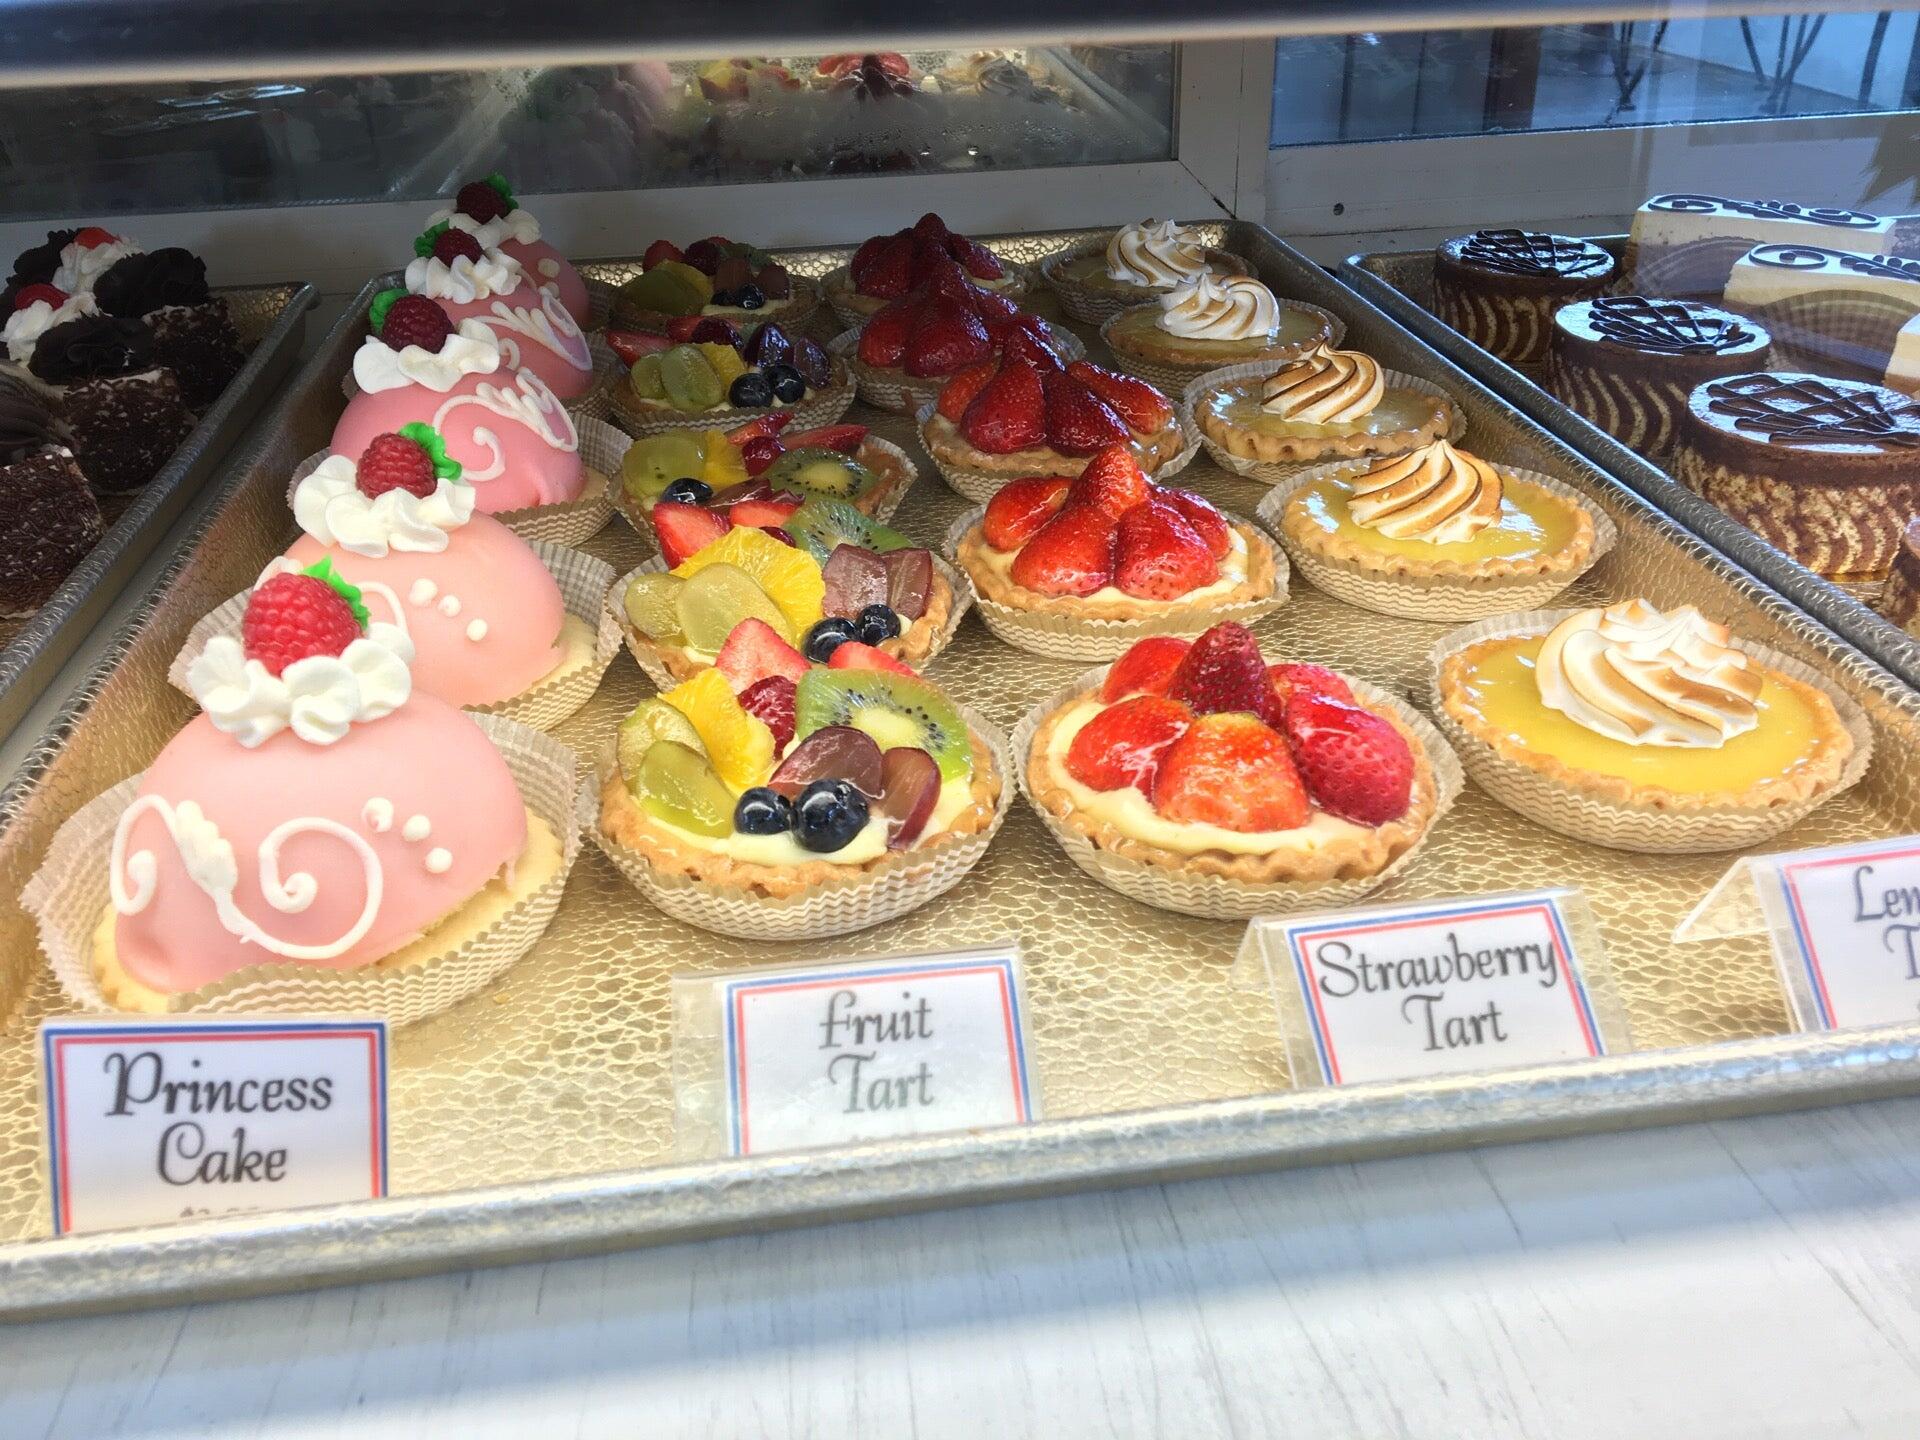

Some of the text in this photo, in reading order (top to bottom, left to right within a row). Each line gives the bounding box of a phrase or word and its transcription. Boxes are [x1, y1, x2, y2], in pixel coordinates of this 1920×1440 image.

[1317, 933, 1558, 997] Strawberry
[1402, 992, 1508, 1051] Tart
[104, 1052, 333, 1117] Princess
[828, 1051, 934, 1114] Tart
[157, 1121, 288, 1186] Cake
